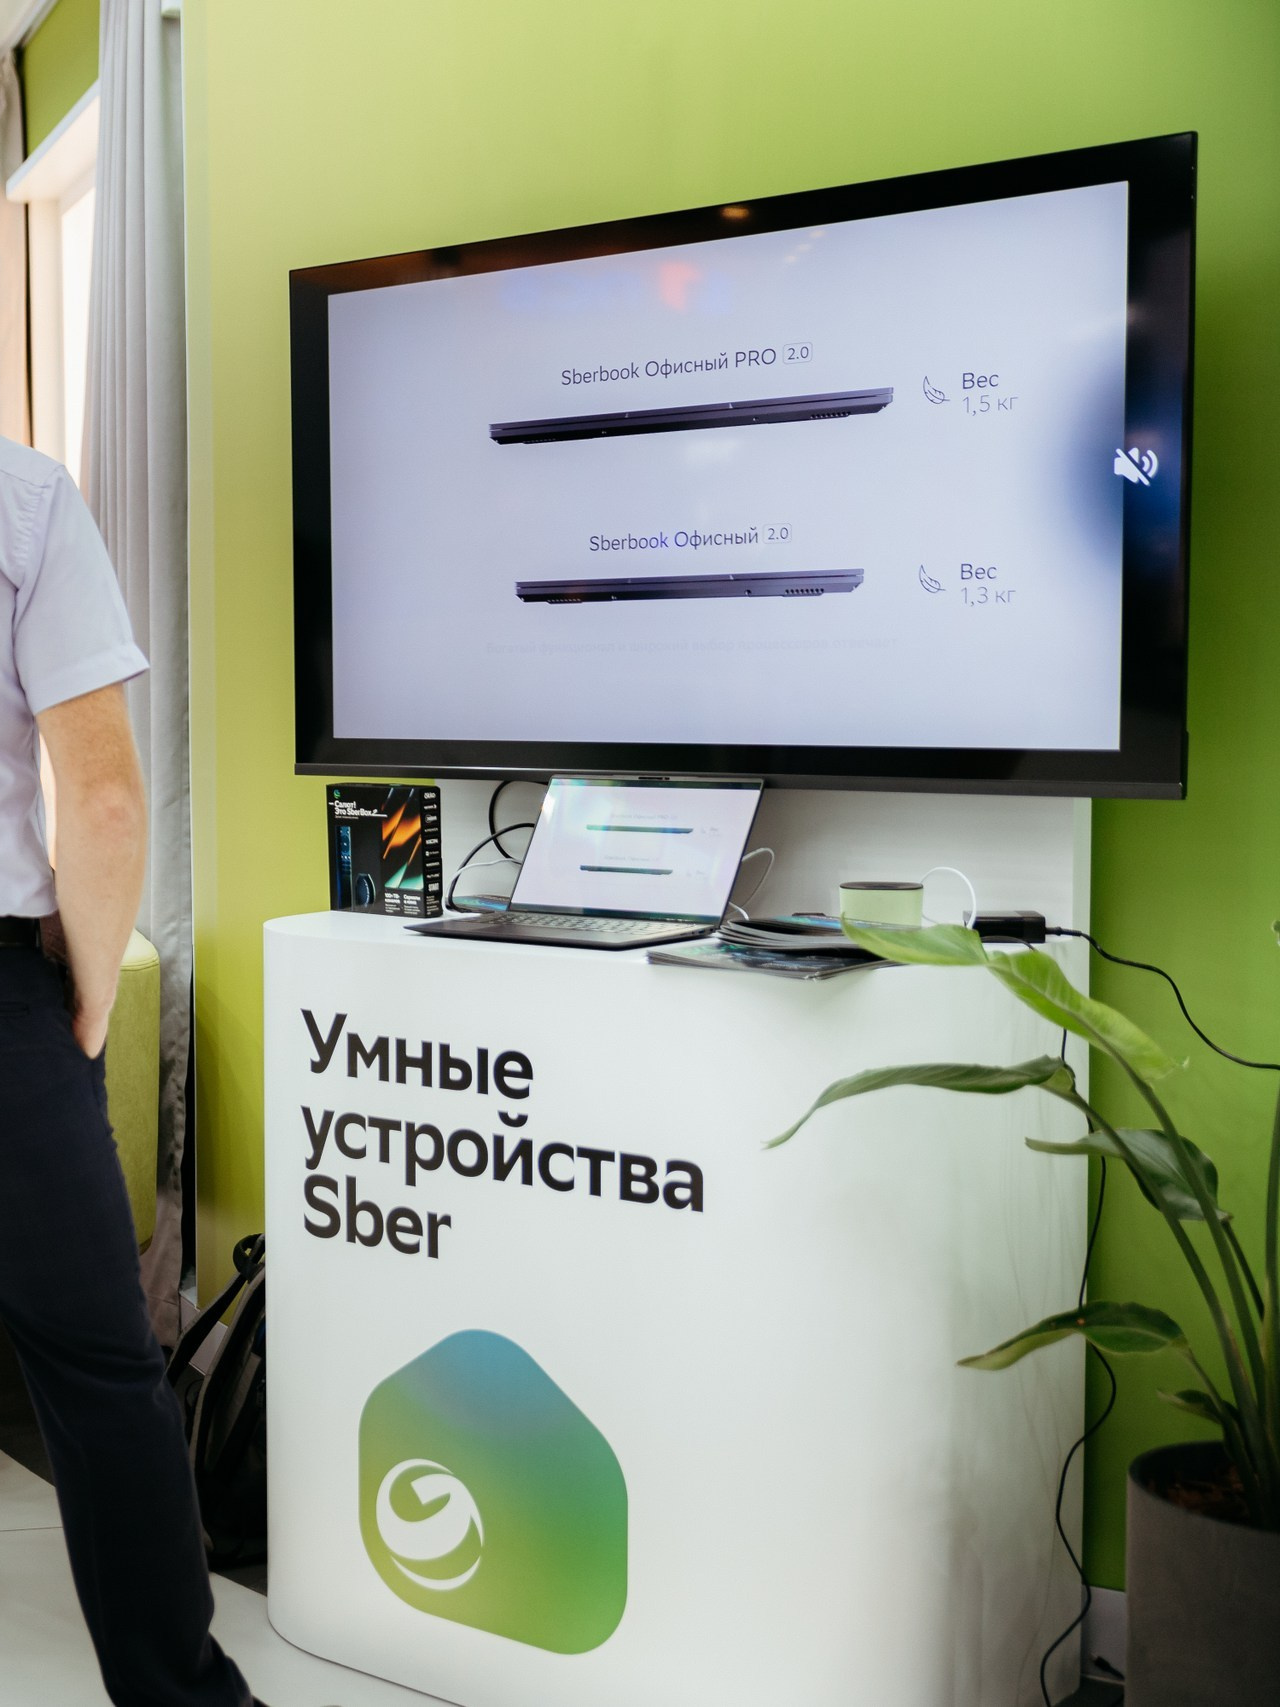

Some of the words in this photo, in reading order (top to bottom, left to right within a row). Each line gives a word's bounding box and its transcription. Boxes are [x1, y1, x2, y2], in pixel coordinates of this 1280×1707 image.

[560, 362, 640, 386] Sberbook
[645, 352, 729, 379] Офисный
[734, 348, 777, 368] PRO
[786, 346, 810, 361] 2.0
[962, 372, 1000, 390] Вес
[962, 394, 991, 417] 1,5
[997, 396, 1019, 411] кг
[589, 532, 669, 552] Sberbook
[674, 527, 759, 551] Офисный
[766, 526, 790, 541] 2.0
[960, 563, 998, 581] Вес
[960, 586, 989, 607] 1,3
[995, 590, 1016, 604] кг
[300, 1007, 534, 1100] Умные
[300, 1104, 704, 1213] устройства
[303, 1173, 452, 1260] Sber
